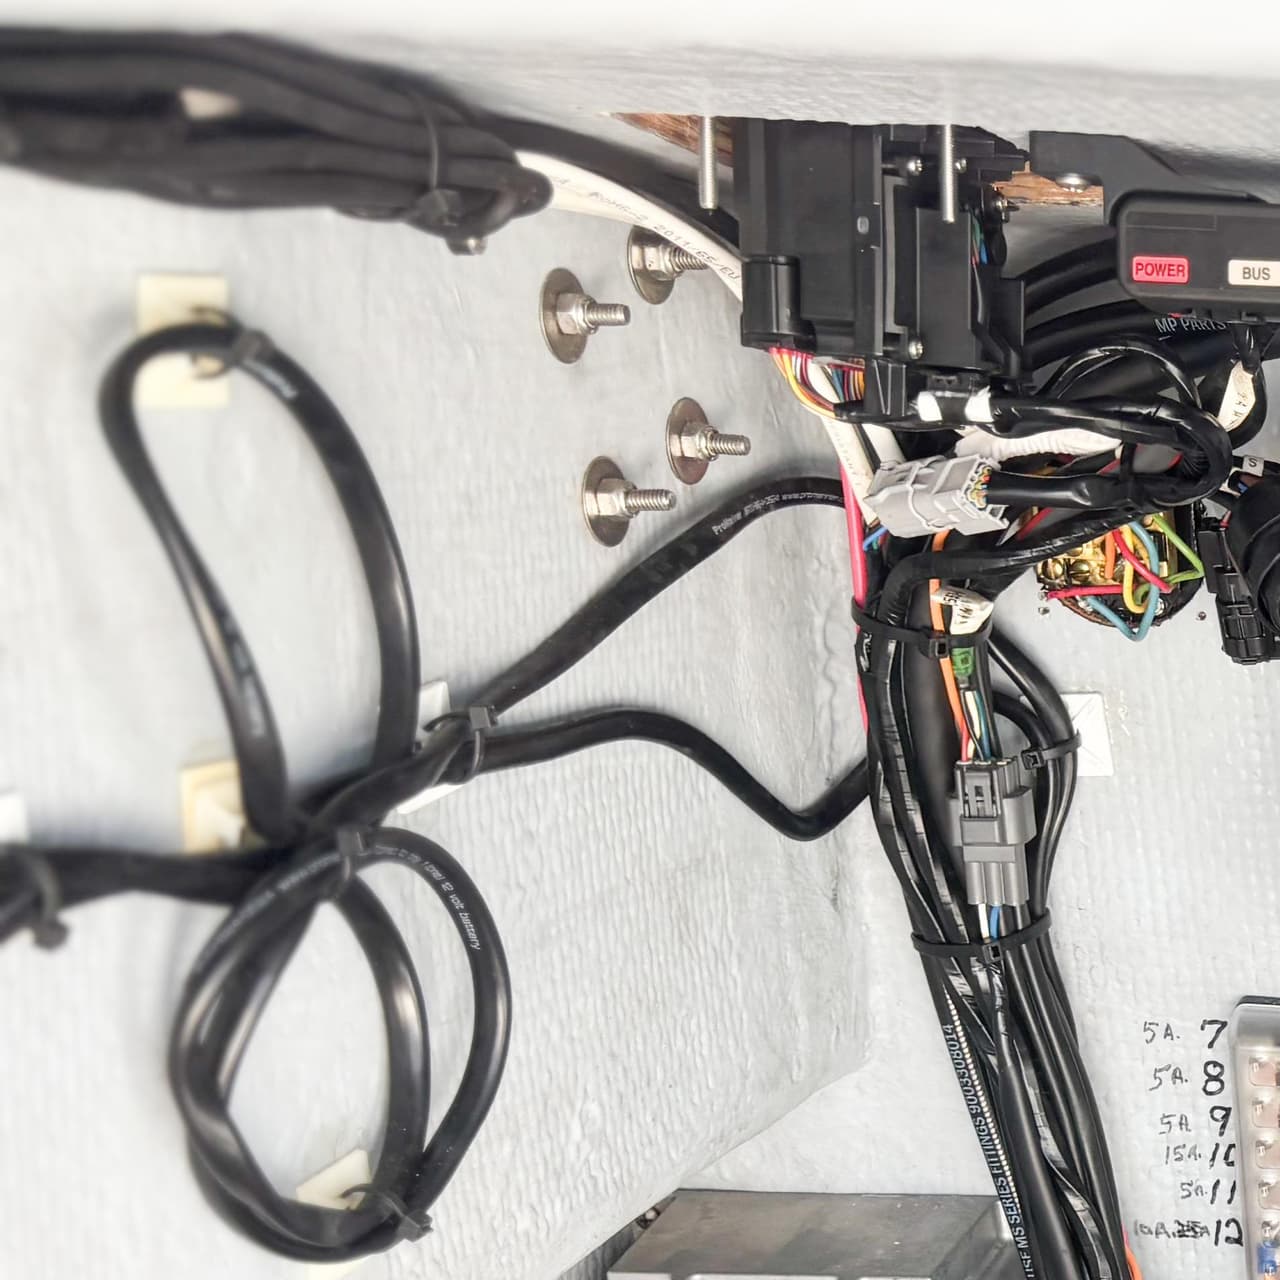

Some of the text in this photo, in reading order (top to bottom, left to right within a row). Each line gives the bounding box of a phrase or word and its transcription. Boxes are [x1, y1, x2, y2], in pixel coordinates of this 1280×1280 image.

[1134, 262, 1186, 278] POWER
[1242, 266, 1271, 281] BUS
[449, 893, 465, 911] volt
[459, 912, 481, 951] battery
[1200, 1018, 1228, 1049] 7
[1201, 1060, 1226, 1097] 8
[1208, 1105, 1233, 1138] 9
[973, 1116, 1004, 1175] FITTINGS
[994, 1175, 1022, 1225] SERIES
[1209, 1178, 1237, 1205] 11
[1214, 1217, 1244, 1248] 12
